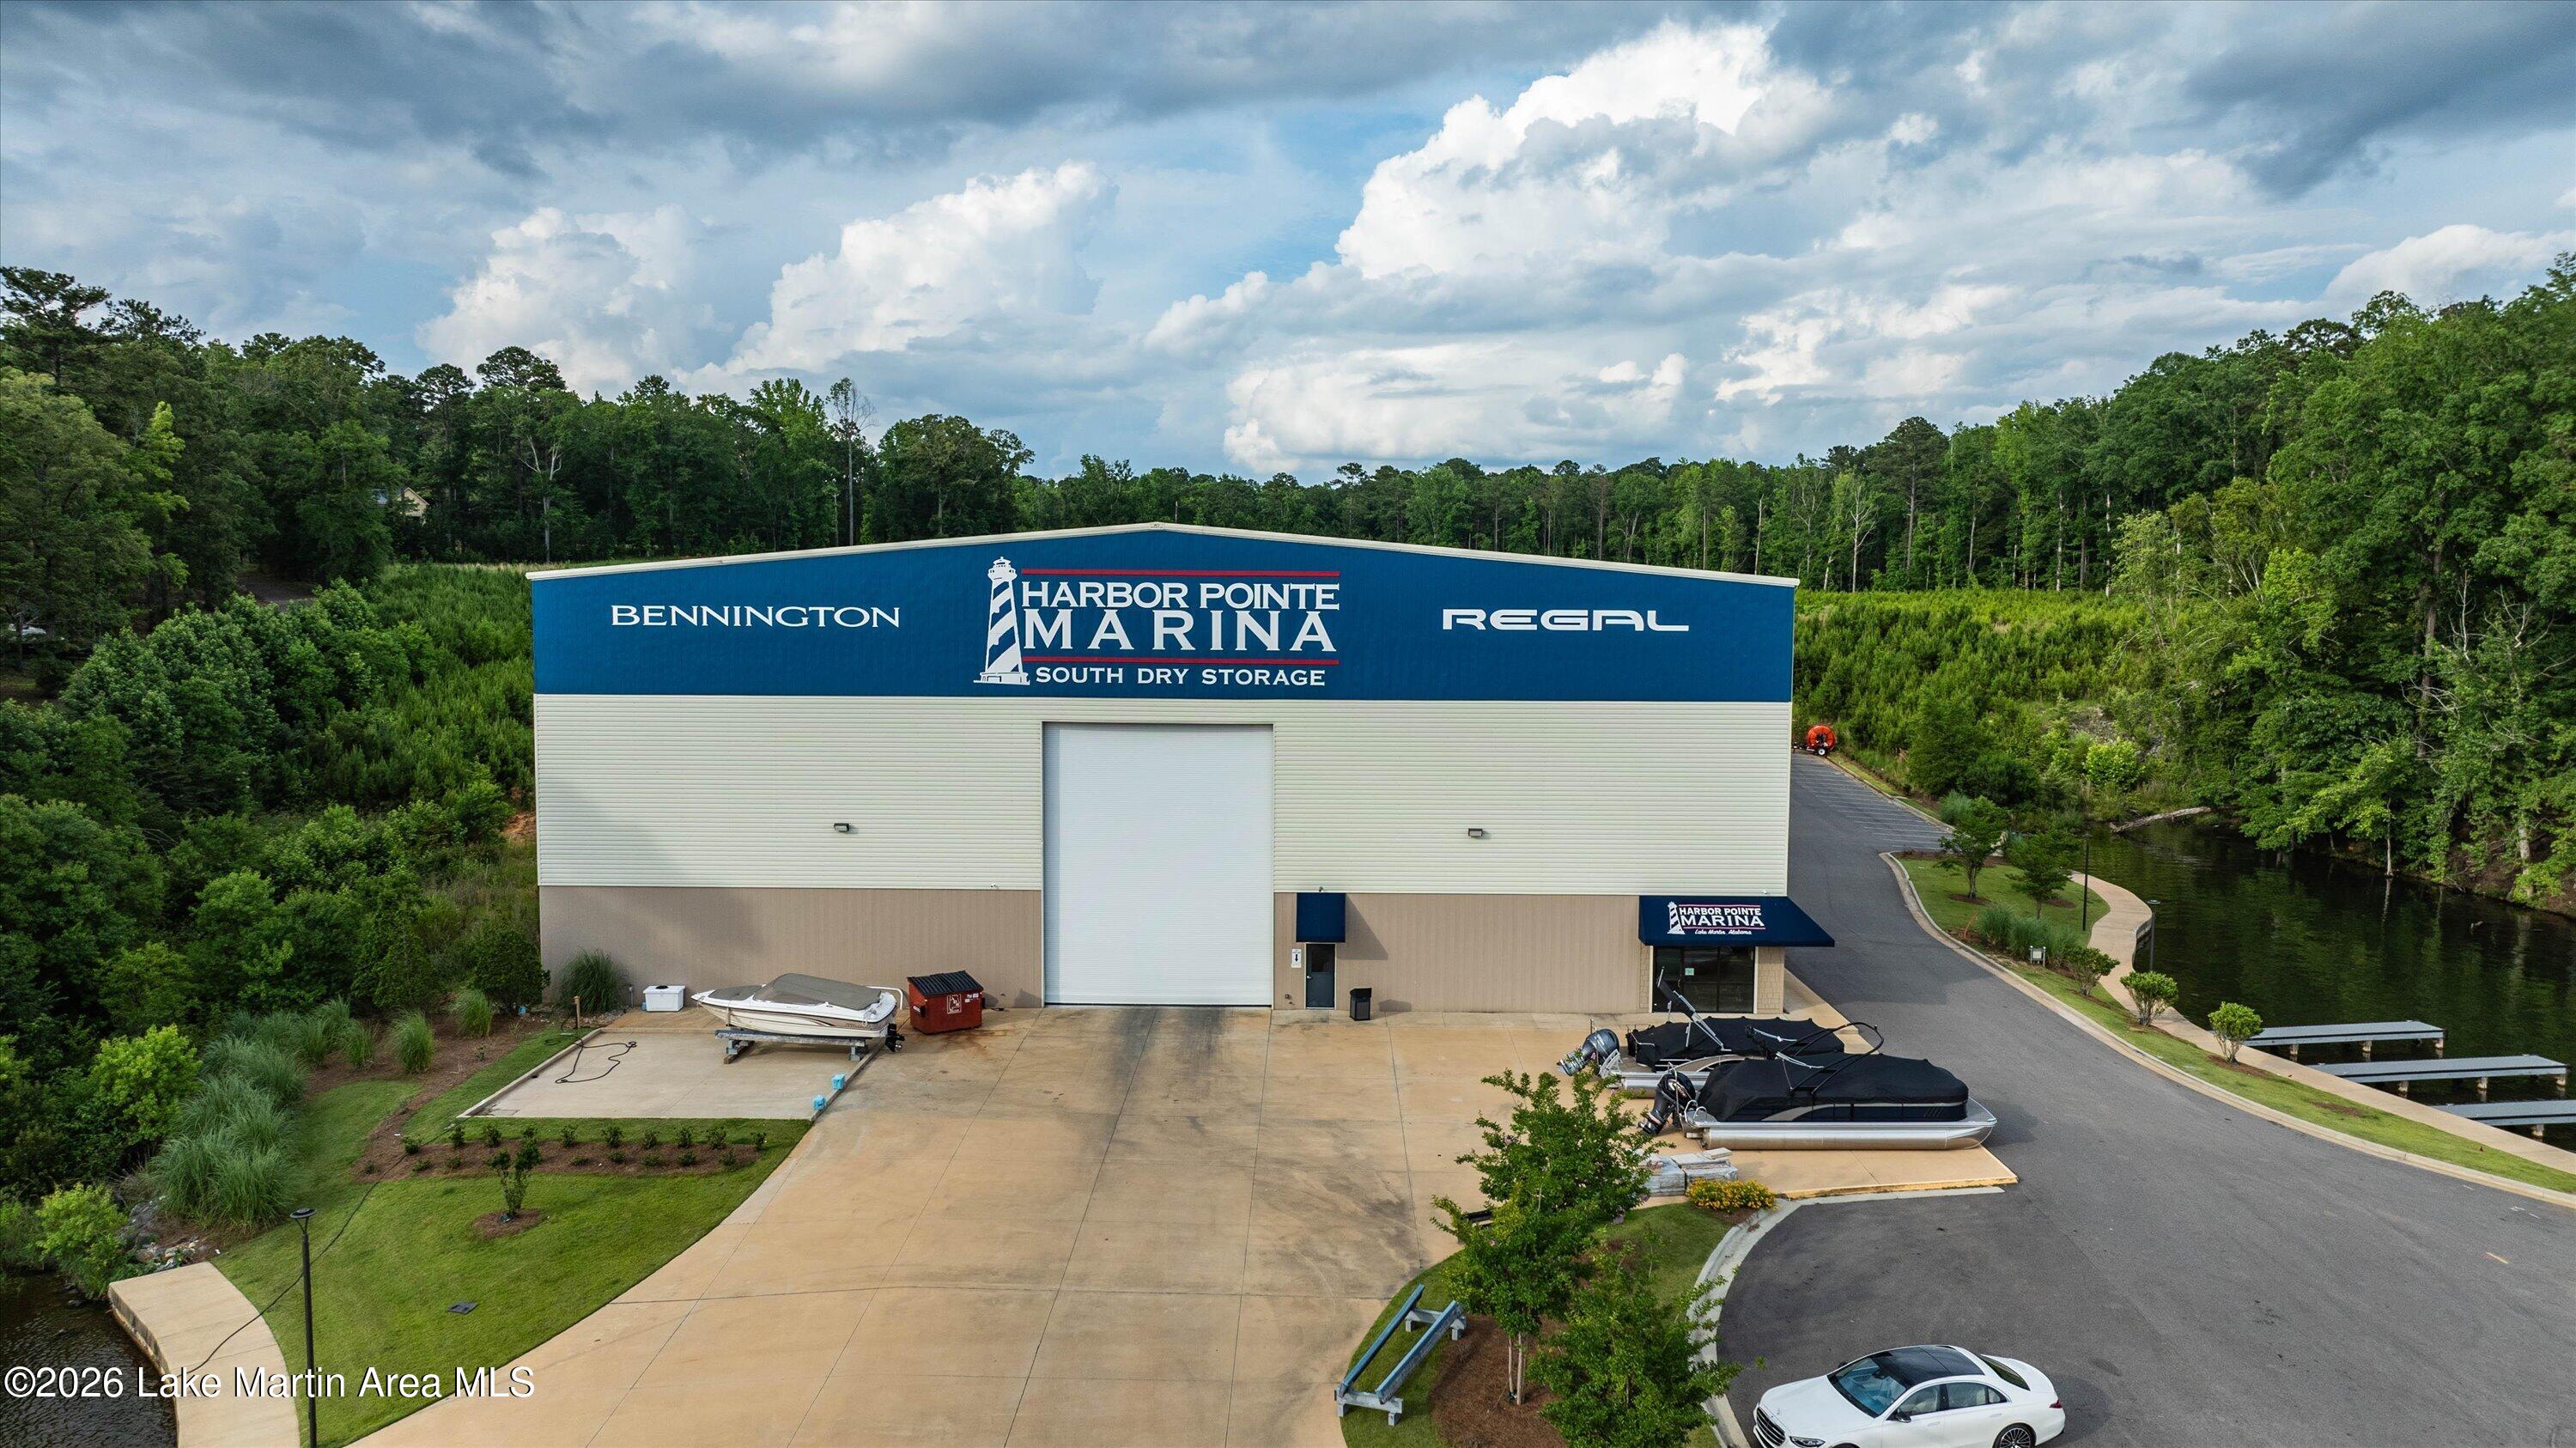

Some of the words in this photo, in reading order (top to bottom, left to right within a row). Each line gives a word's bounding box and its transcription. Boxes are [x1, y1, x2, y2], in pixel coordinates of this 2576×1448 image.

[1021, 581, 1188, 608] HARBOR
[1200, 582, 1340, 611] POINTE
[611, 605, 900, 628] BENNINGTON
[1443, 608, 1690, 632] REGAL
[1024, 608, 1337, 652] MARINA
[1036, 666, 1123, 684] SOUTH
[1137, 667, 1189, 684] DRY
[1201, 668, 1326, 686] STORAGE
[1679, 907, 1722, 916] HARBOR
[1723, 907, 1762, 916] POINTE
[1680, 915, 1765, 927] MARINA
